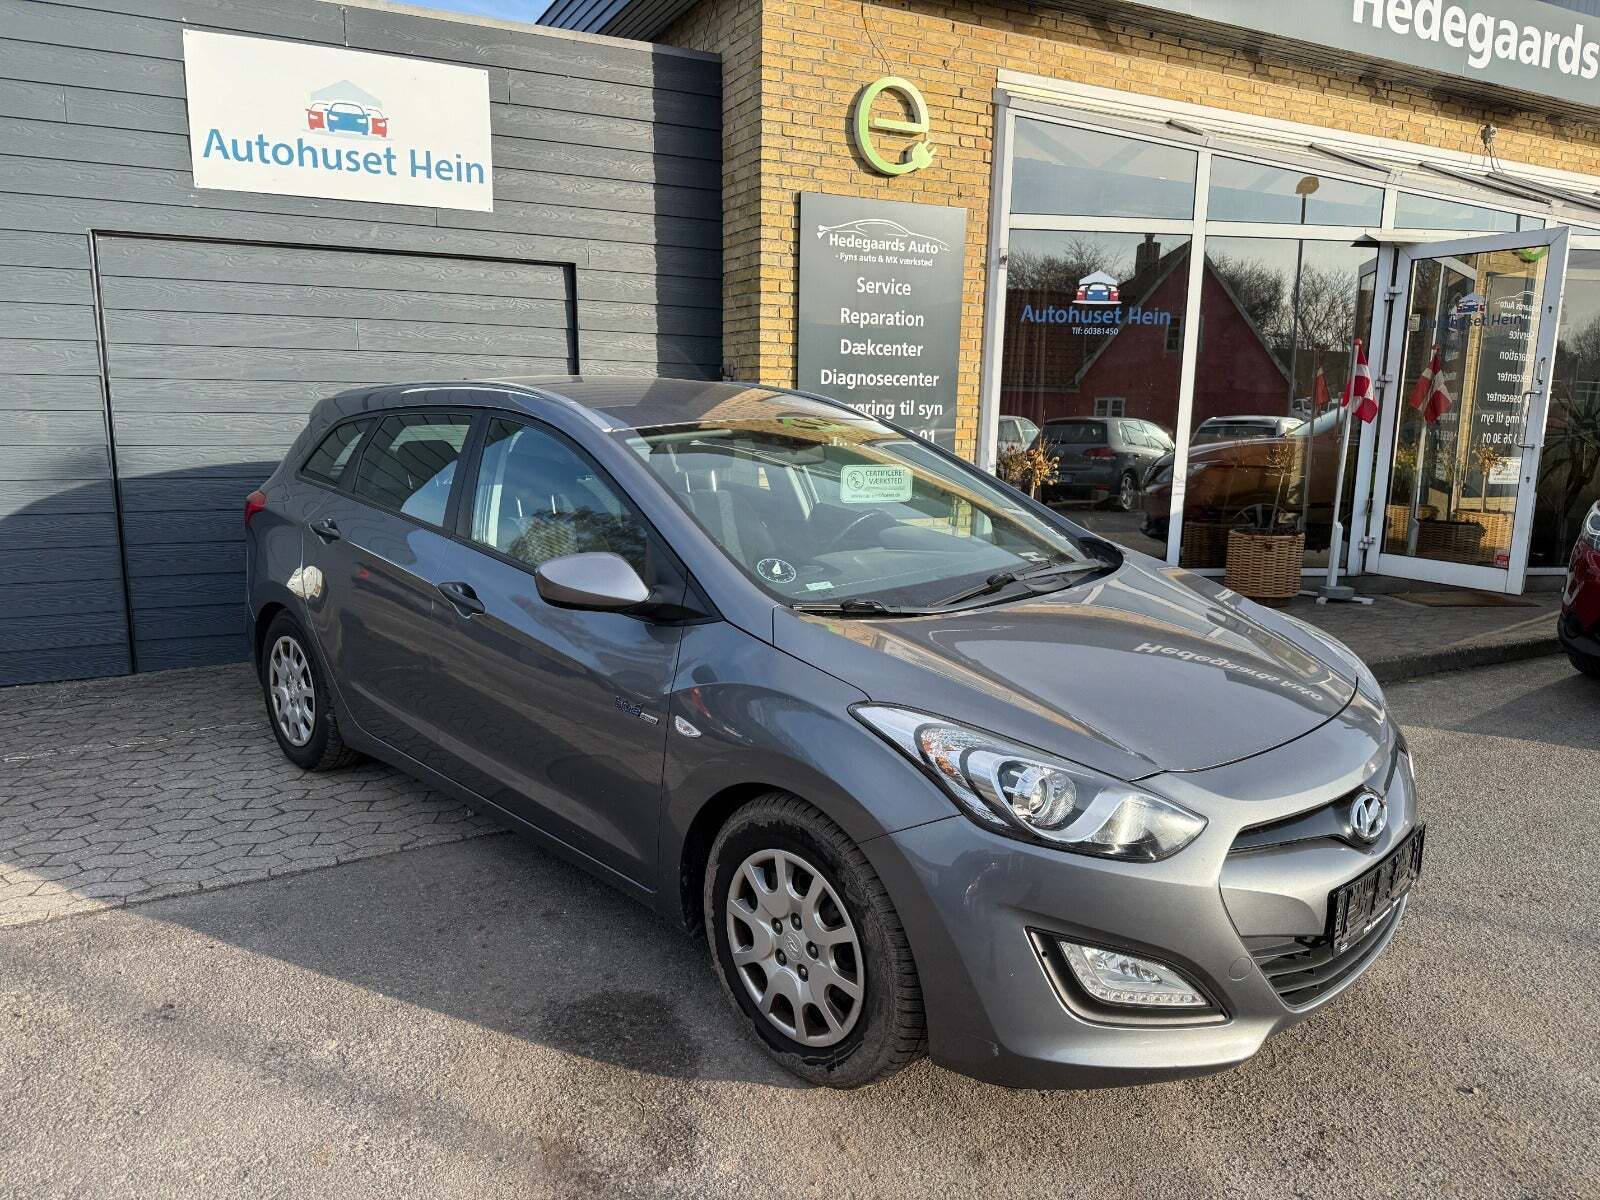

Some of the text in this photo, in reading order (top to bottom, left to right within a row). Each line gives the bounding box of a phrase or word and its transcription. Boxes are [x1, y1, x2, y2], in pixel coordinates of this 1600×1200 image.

[1352, 0, 1600, 80] Hedegaards
[202, 128, 485, 184] Autohuset Hein
[829, 233, 939, 255] Hedegaards Auto
[840, 253, 858, 262] Fyns
[859, 255, 877, 263] auto
[878, 255, 884, 263] &
[886, 256, 898, 264] MX
[900, 257, 933, 267] værksted
[856, 276, 912, 296] Service
[840, 307, 924, 328] Reparation
[1020, 304, 1172, 325] Autohuset Hein
[1492, 314, 1522, 326] Hein
[1084, 326, 1119, 335] 60381450
[840, 338, 924, 357] Dækcenter
[820, 369, 940, 389] Diagnosecenter
[899, 400, 914, 416] til
[918, 404, 943, 420] syn
